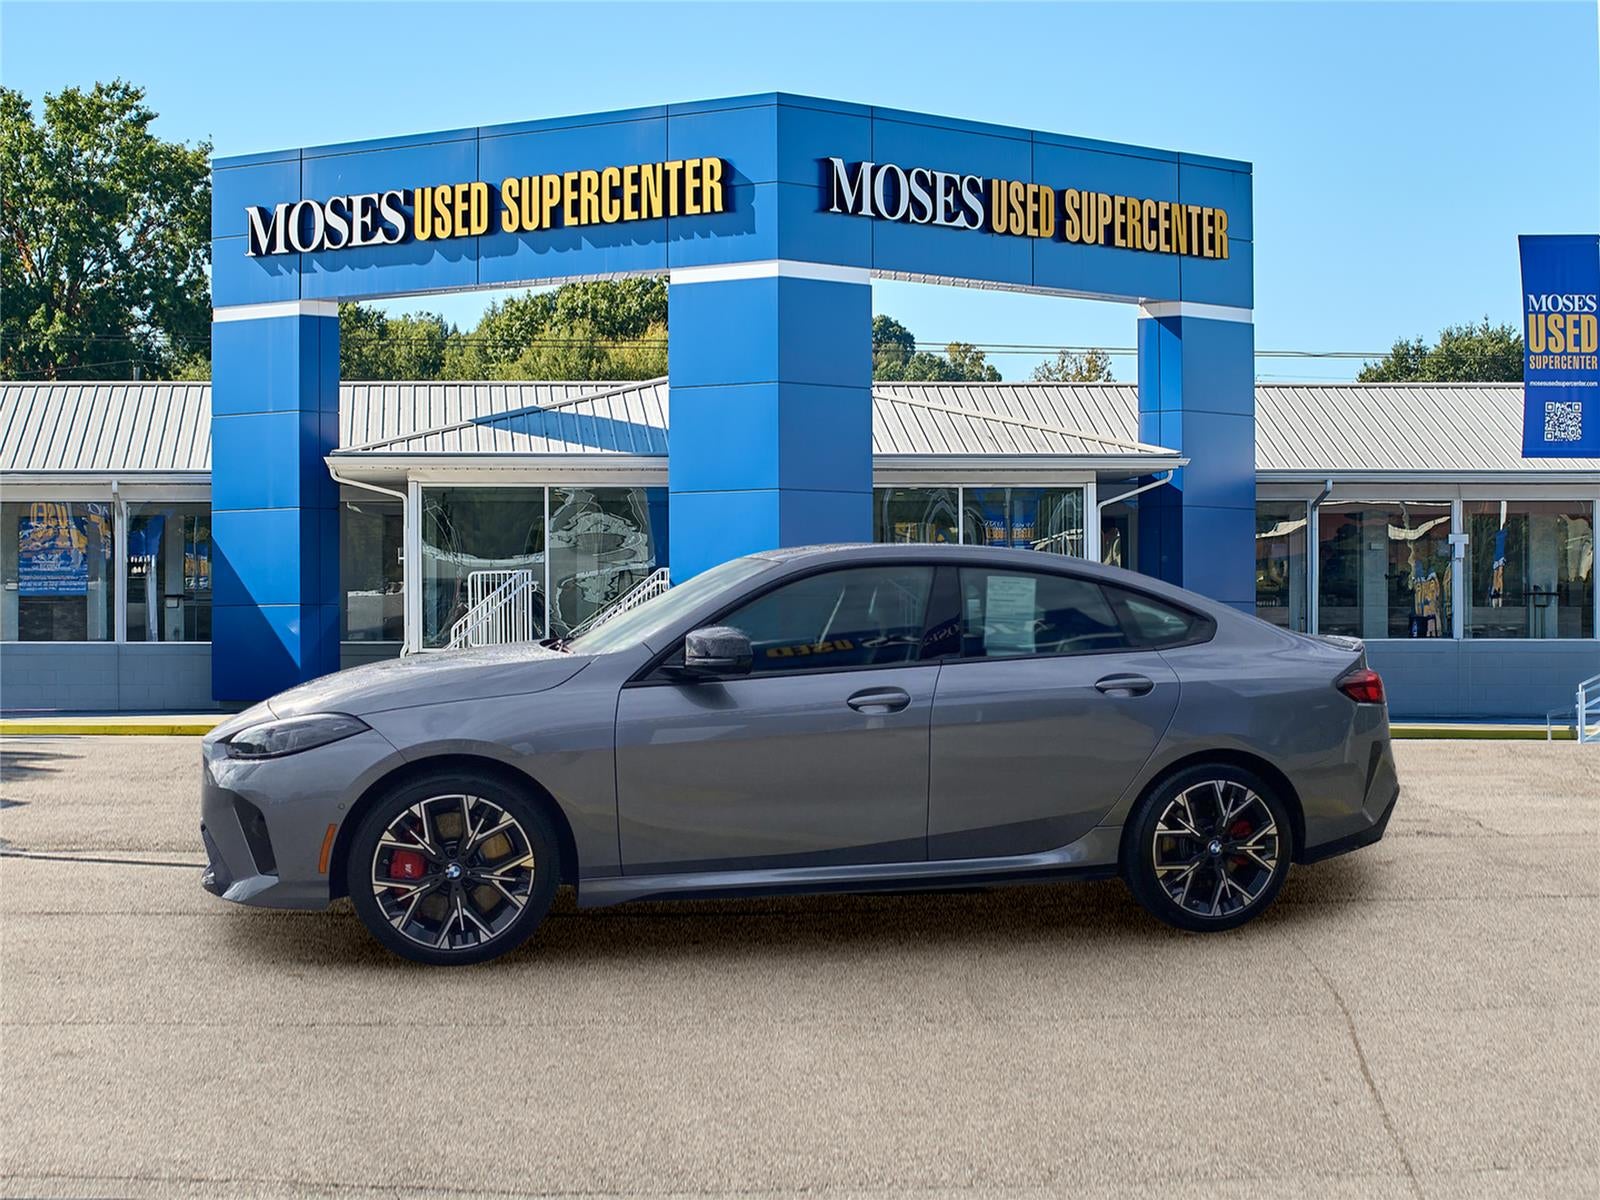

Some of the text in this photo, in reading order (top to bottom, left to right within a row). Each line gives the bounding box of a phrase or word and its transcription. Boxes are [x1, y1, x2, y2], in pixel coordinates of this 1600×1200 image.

[244, 157, 724, 257] MOSES USED SUPERCENTER
[829, 157, 1229, 259] MOSES USED SUPERCENTER
[1528, 294, 1597, 312] MOSES
[1528, 313, 1598, 353] USED
[1529, 355, 1598, 369] SUPERCENTER
